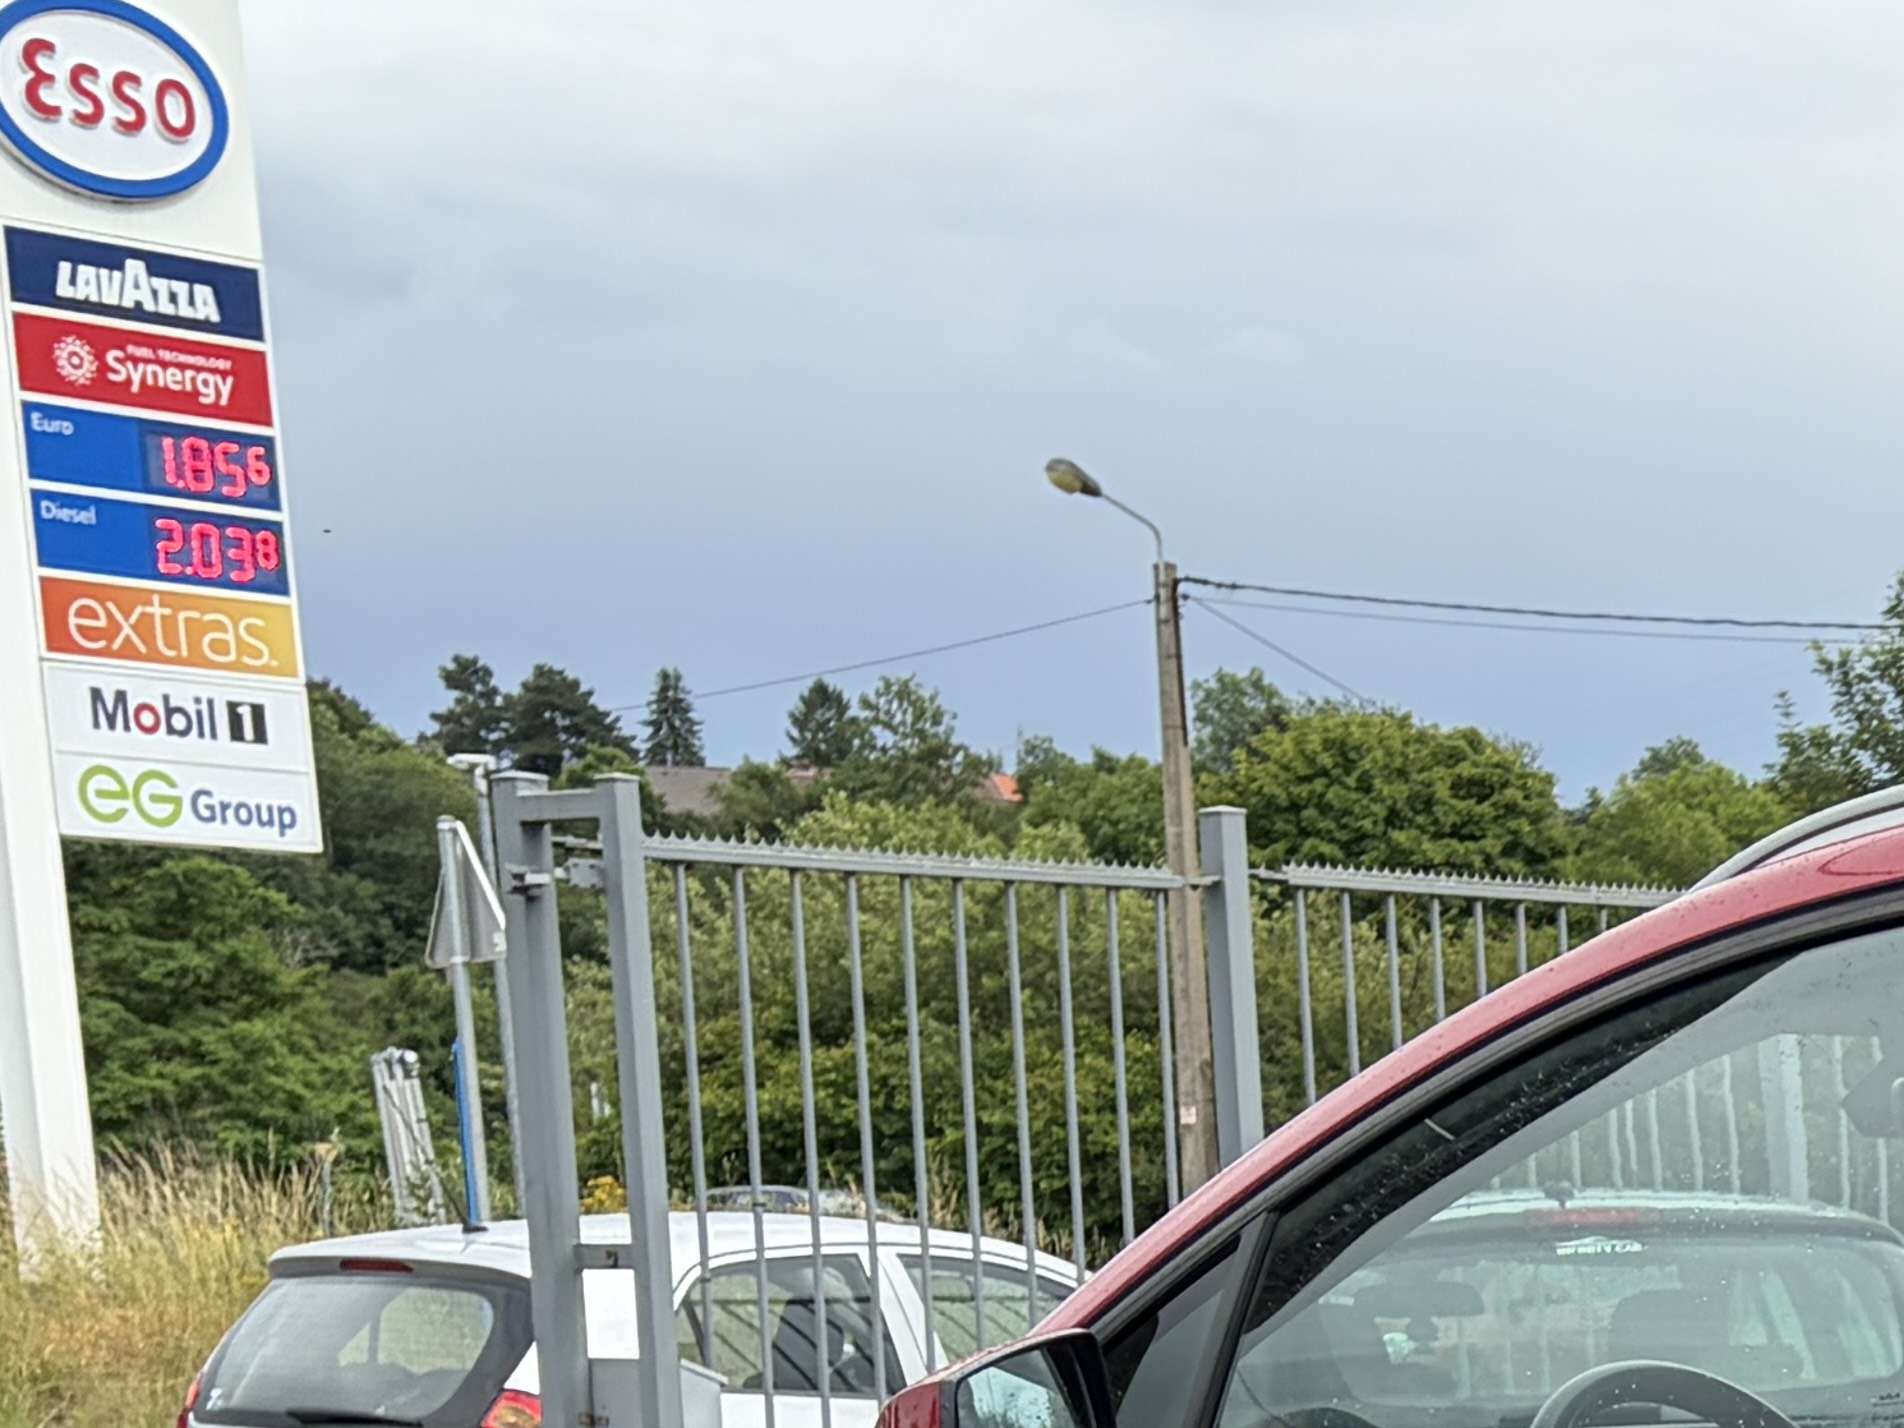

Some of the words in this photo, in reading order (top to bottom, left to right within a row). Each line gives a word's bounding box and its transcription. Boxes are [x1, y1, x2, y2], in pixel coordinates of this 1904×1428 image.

[104, 349, 234, 407] Synergy
[29, 412, 74, 435] Euro
[40, 501, 97, 526] Diesel
[89, 686, 219, 742] Mobil
[189, 788, 298, 838] Group
